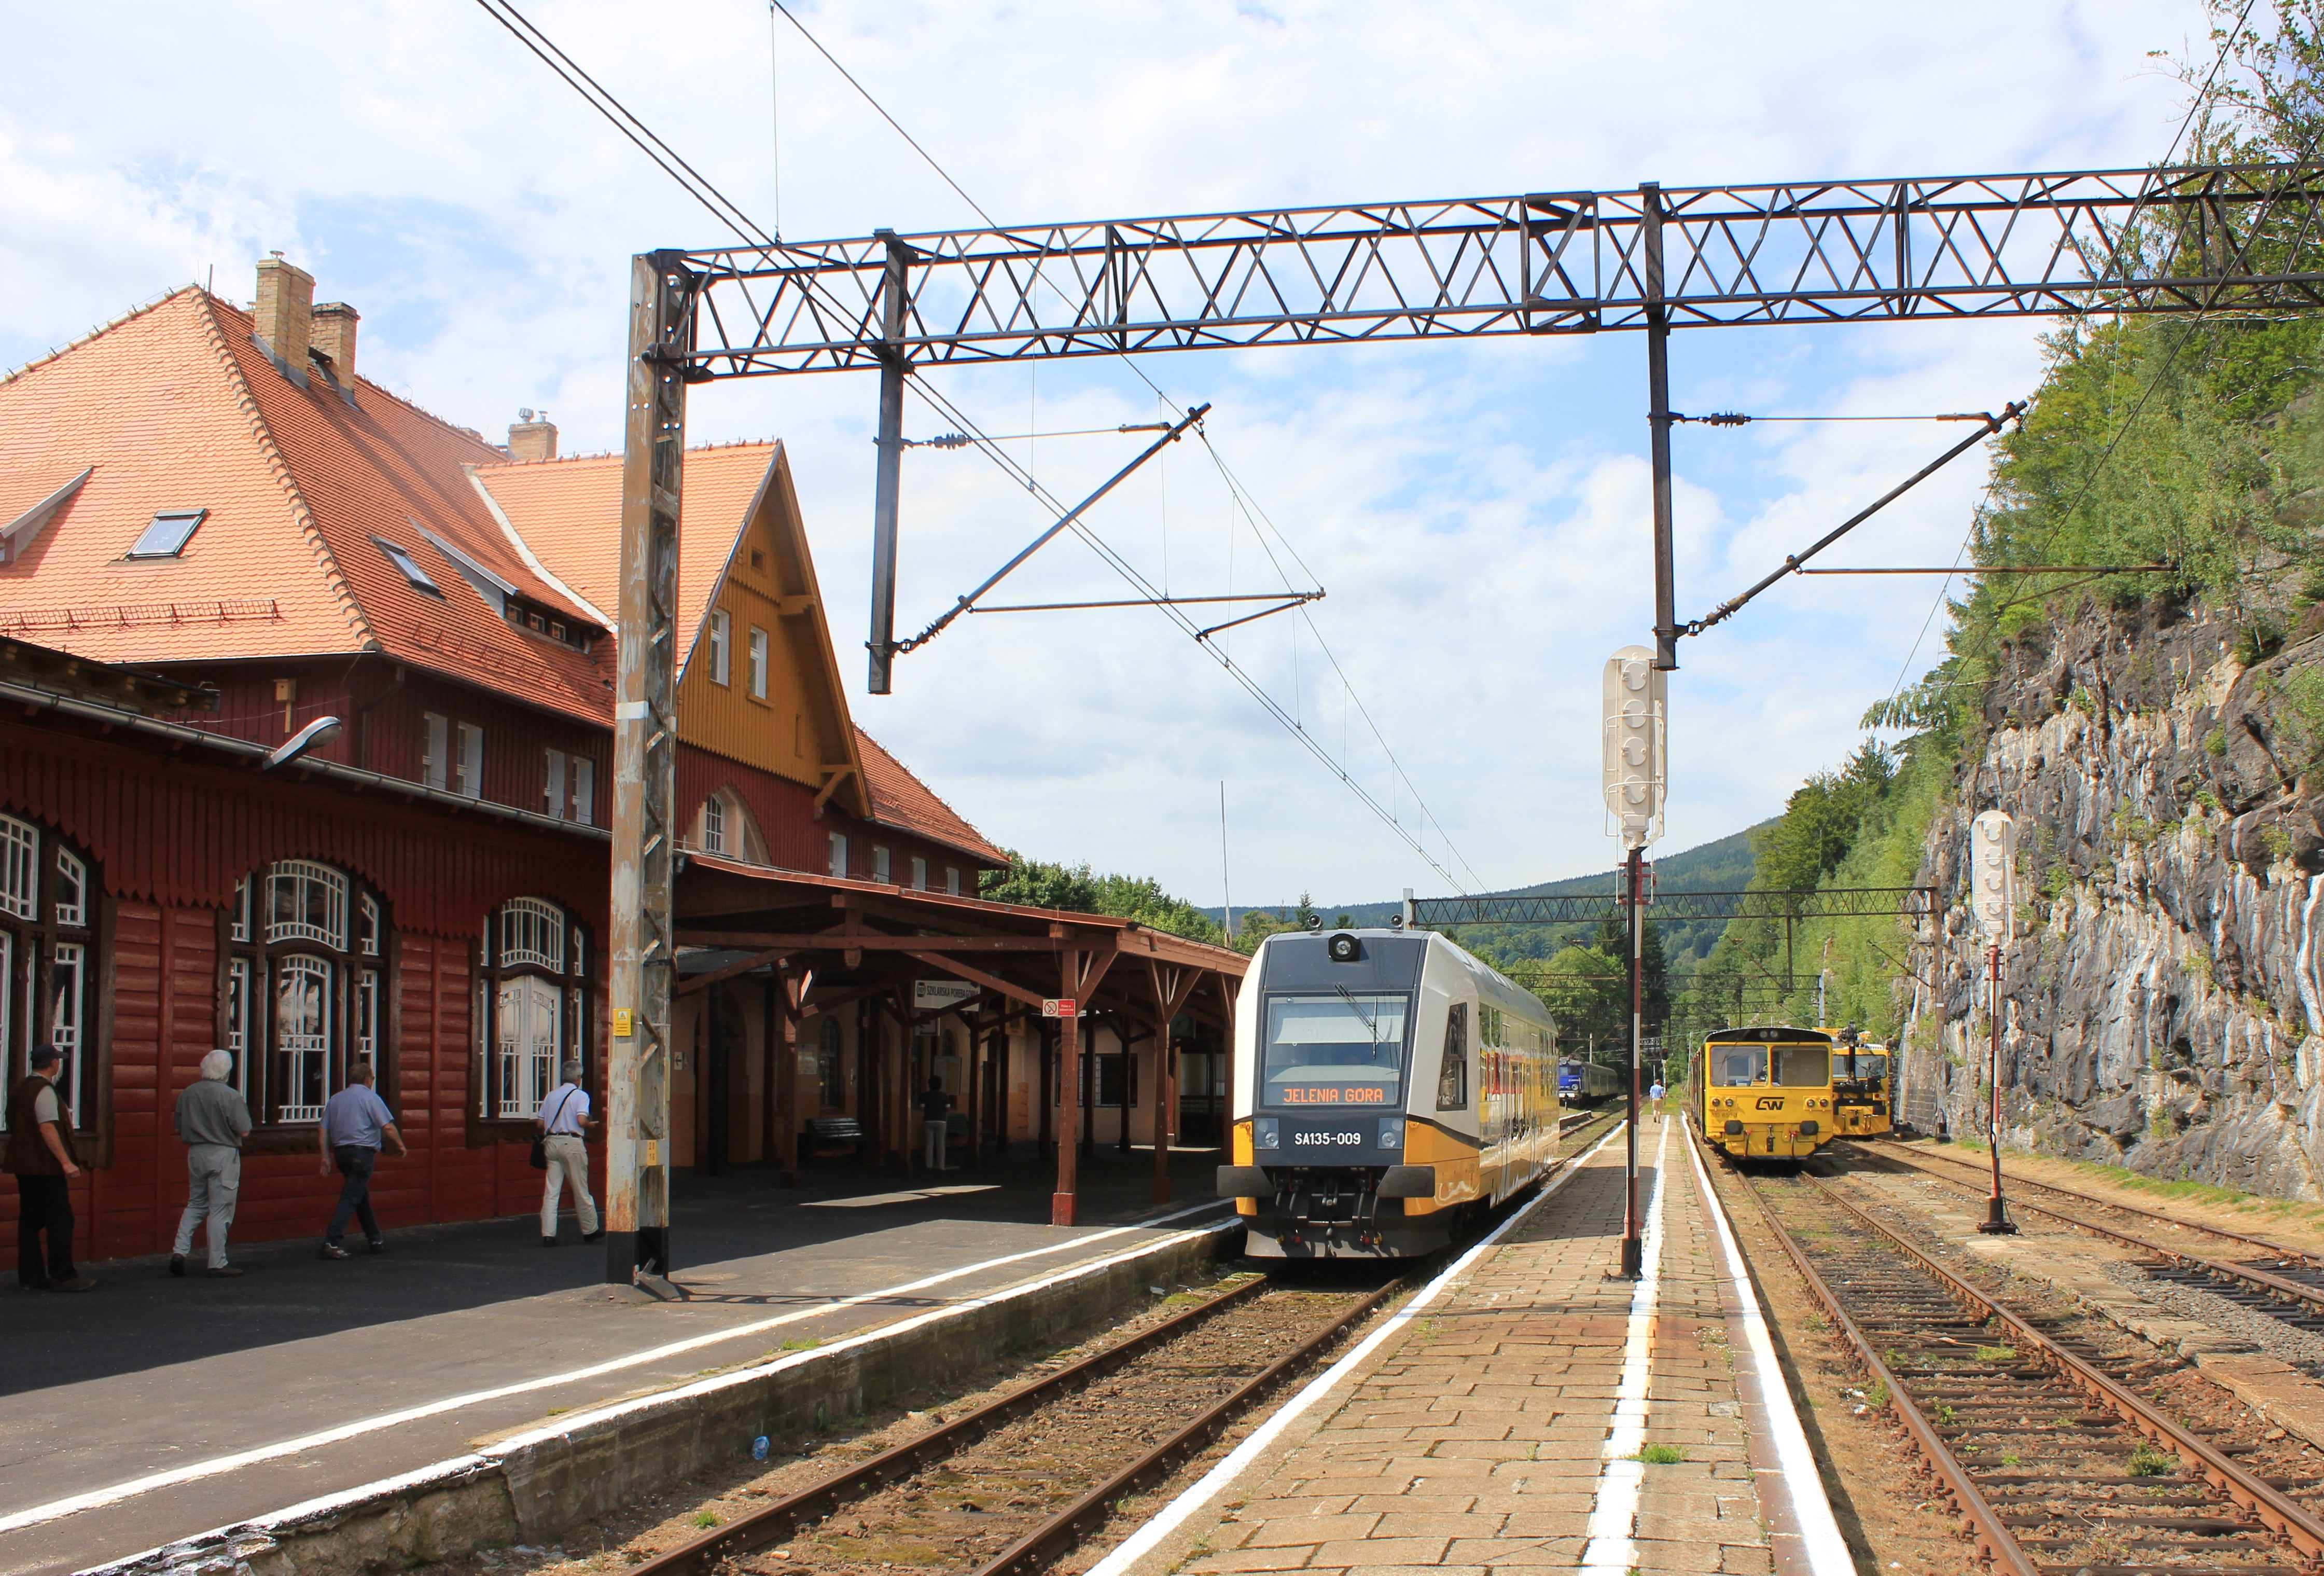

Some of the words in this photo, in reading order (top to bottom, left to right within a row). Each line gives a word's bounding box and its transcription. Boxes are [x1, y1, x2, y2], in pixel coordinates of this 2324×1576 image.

[1284, 1088, 1339, 1103] JELENIA
[1345, 1087, 1384, 1103] GÓRA
[1295, 1132, 1361, 1145] SA135-009
